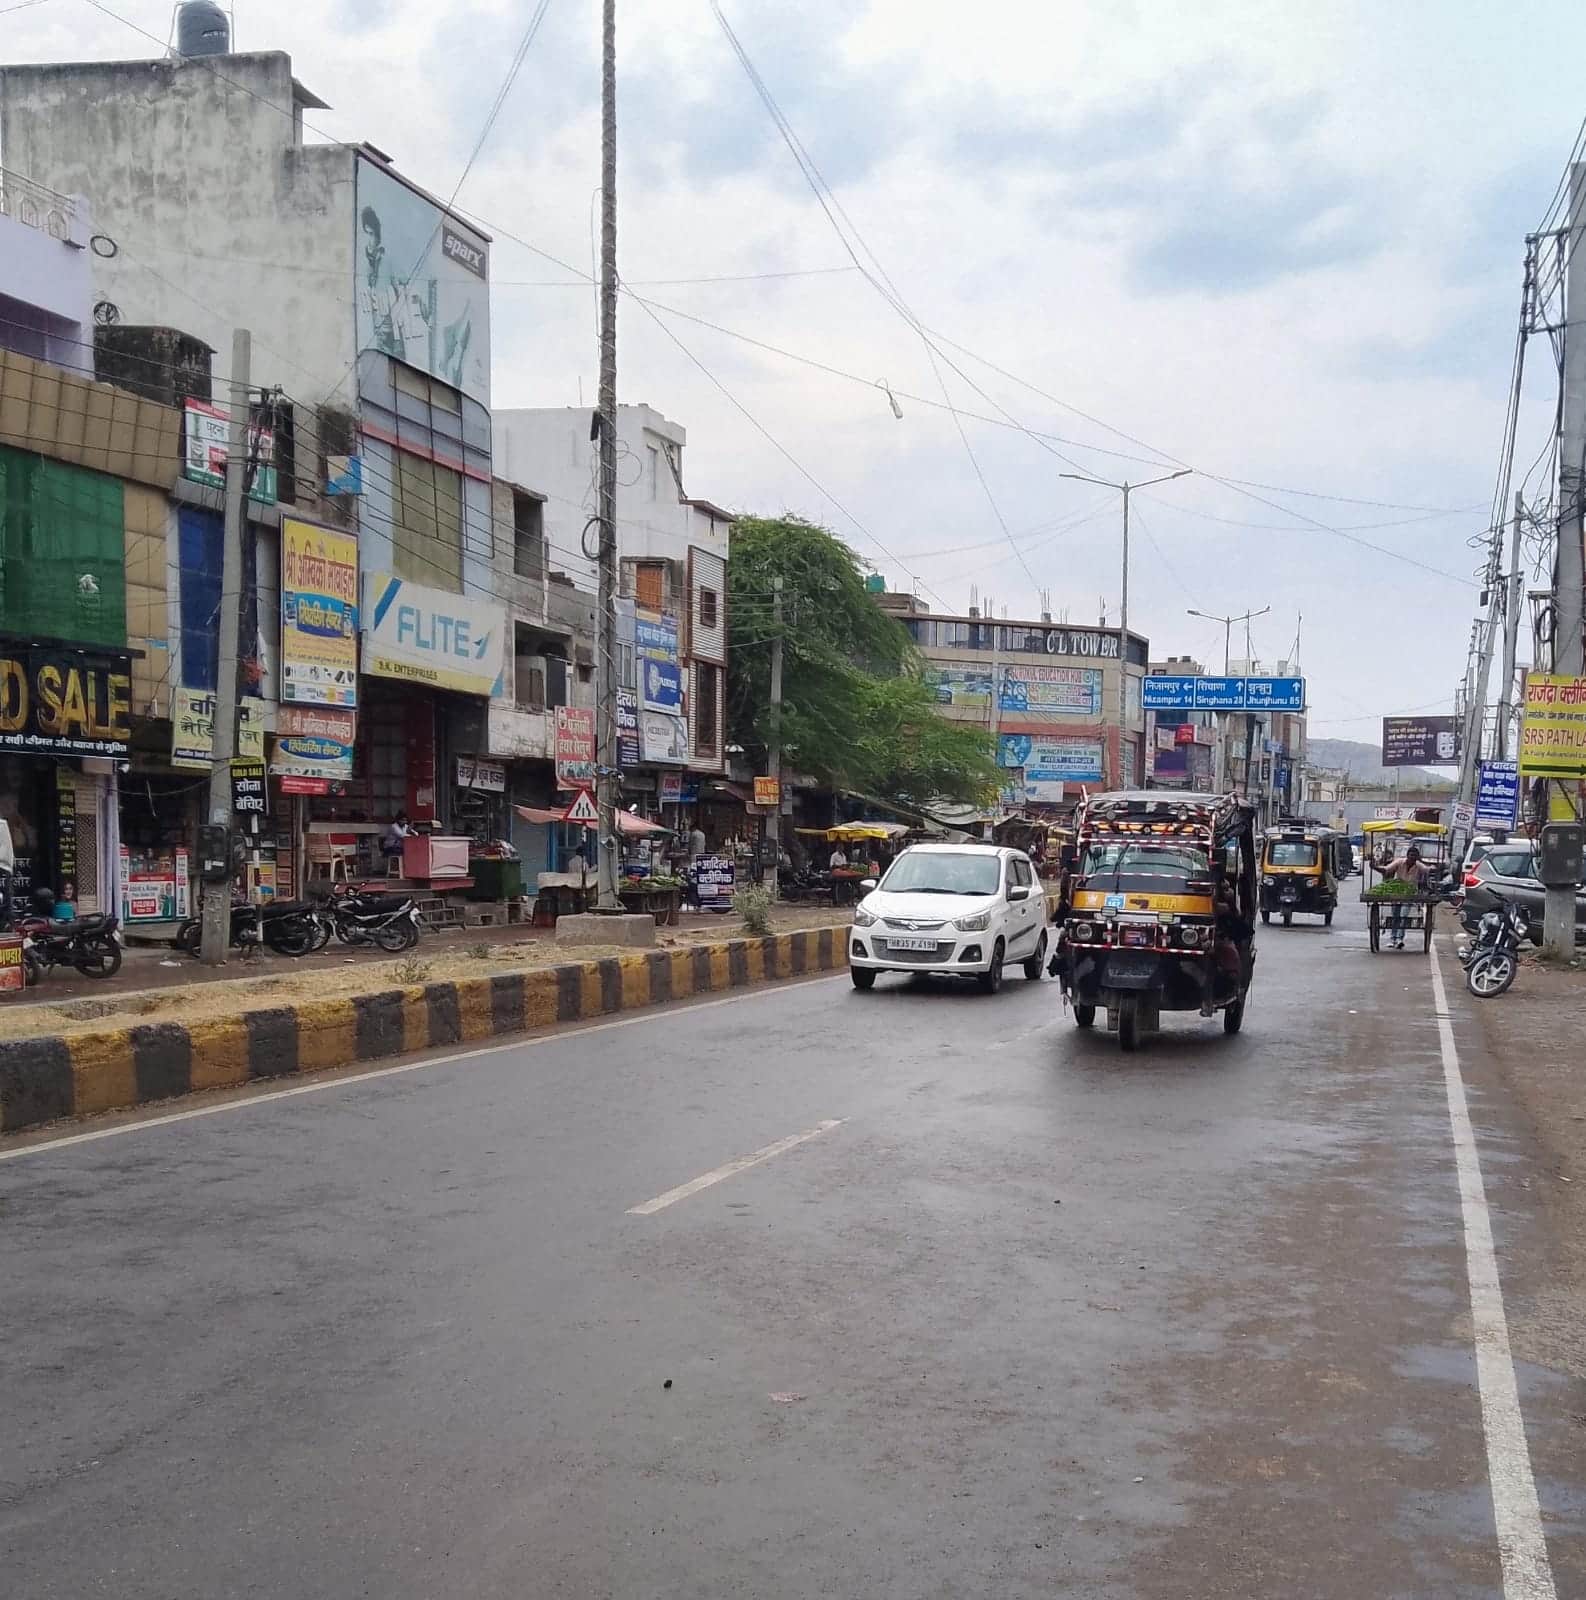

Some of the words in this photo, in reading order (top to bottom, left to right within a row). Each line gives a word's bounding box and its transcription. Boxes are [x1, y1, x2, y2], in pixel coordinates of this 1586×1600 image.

[445, 235, 483, 267] sparx
[397, 606, 471, 658] FLITE
[1038, 668, 1070, 682] EDUCATION
[37, 665, 130, 740] SALE
[1144, 695, 1181, 705] Nizampur
[1184, 695, 1193, 704] 14
[1197, 695, 1232, 706] Singhana
[1247, 695, 1288, 707] Jhunjhunu
[1524, 728, 1545, 745] SRS
[1546, 729, 1574, 746] PATH
[235, 778, 261, 792] सोना
[235, 796, 264, 811] बेचिए
